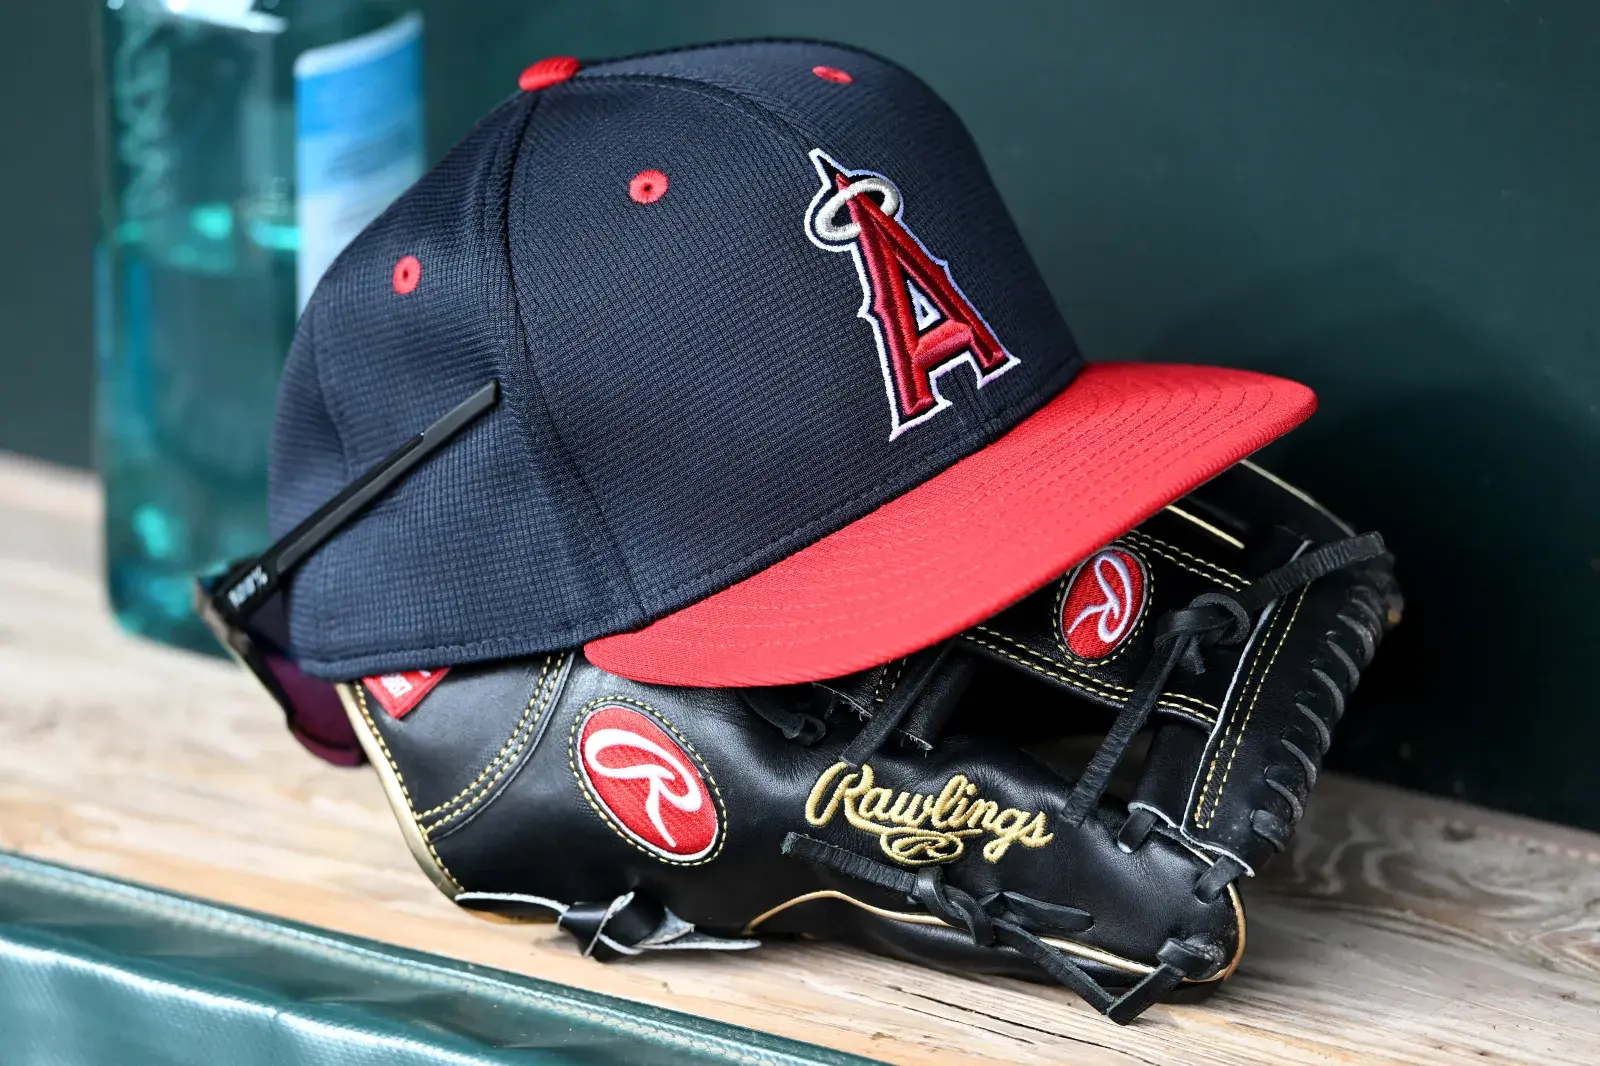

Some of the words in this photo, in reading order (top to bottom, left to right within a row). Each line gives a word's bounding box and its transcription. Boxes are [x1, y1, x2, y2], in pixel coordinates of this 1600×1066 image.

[806, 148, 1020, 440] A
[1067, 551, 1133, 644] R
[584, 728, 703, 848] R
[805, 762, 1053, 864] Rawlings
